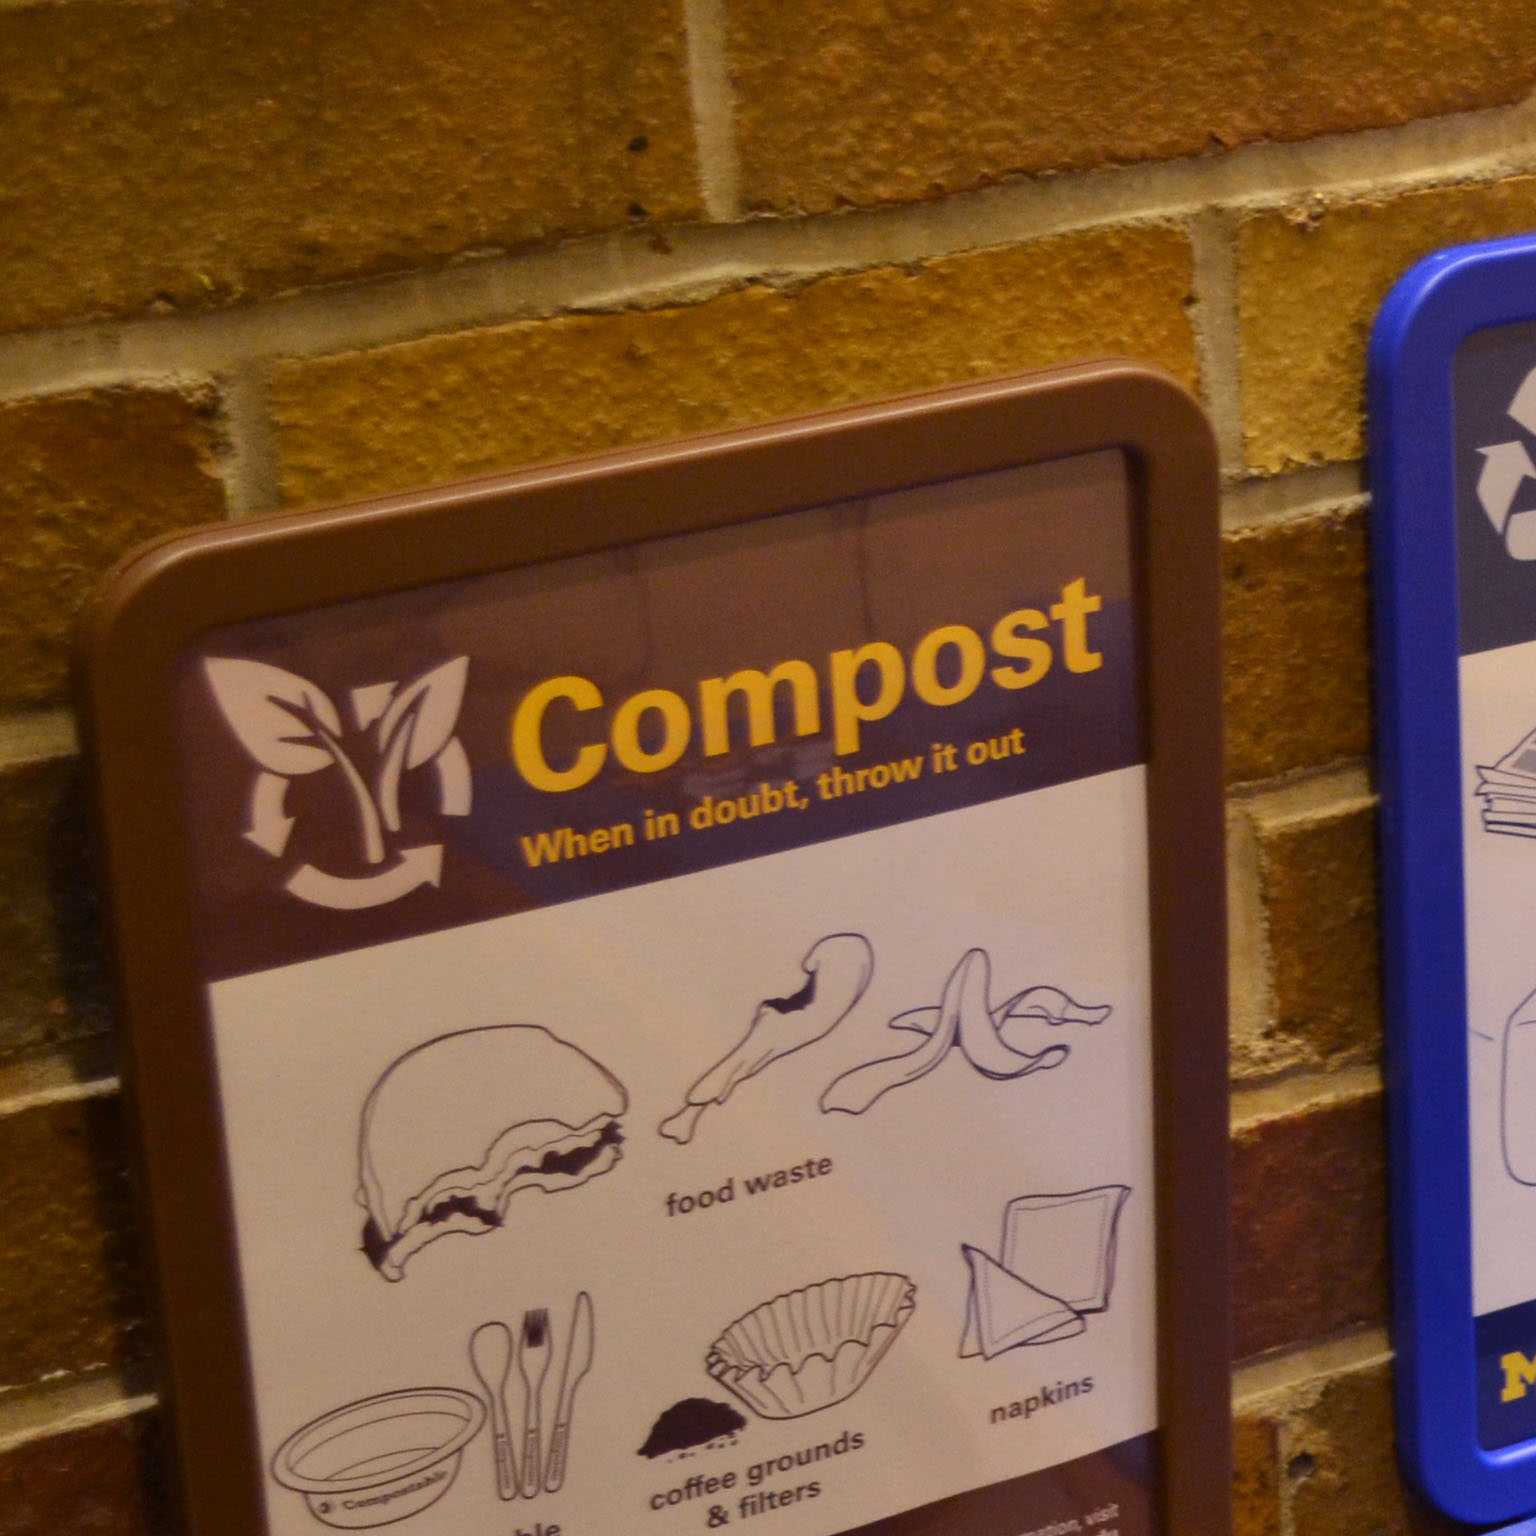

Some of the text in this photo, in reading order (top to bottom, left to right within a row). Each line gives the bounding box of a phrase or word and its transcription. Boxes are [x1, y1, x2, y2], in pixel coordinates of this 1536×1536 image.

[511, 578, 1102, 793] Compost
[521, 727, 1026, 868] When in doubt, throw it out
[664, 1155, 834, 1217] food waste
[989, 1375, 1094, 1425] napkins
[649, 1430, 865, 1512] coffee grounds
[706, 1478, 823, 1530] & filters
[1085, 1502, 1120, 1526] visit
